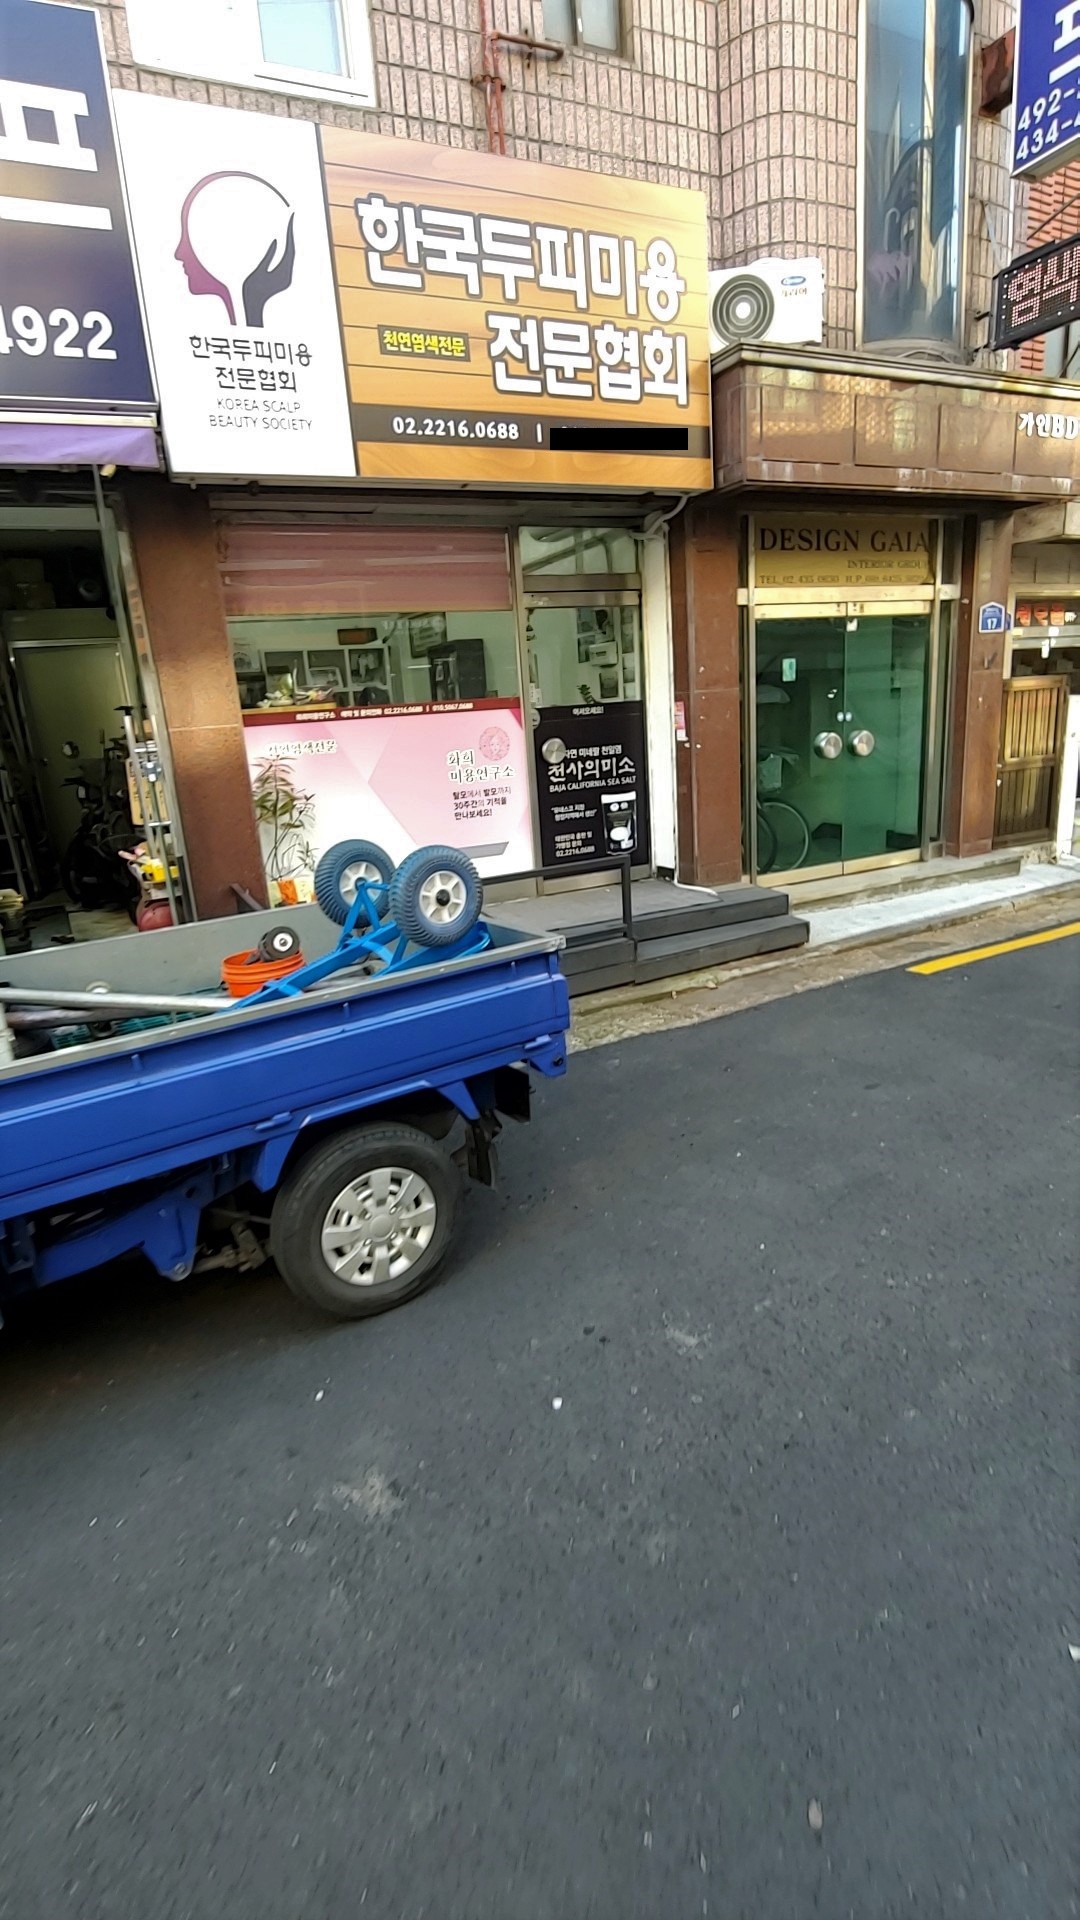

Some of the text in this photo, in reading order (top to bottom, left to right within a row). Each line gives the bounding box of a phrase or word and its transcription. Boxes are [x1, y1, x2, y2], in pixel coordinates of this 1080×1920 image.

[1018, 77, 1080, 130] 492-
[356, 195, 687, 323] 한국두피미용
[189, 335, 312, 367] 한국두피미용
[383, 330, 466, 357] 천연염색전문
[487, 314, 689, 406] 전문협회
[216, 367, 297, 393] 전문협회
[217, 398, 301, 413] KOREA SCALP
[209, 414, 312, 430] BEAUTY SOCIETY
[393, 416, 519, 440] 02.2216.0688
[760, 527, 929, 552] DESIGN GAIA
[450, 766, 514, 784] 미용연구소
[549, 775, 636, 793] BAJA CALIFORNIA SEA SALT
[454, 808, 493, 821] 만나보세요!
